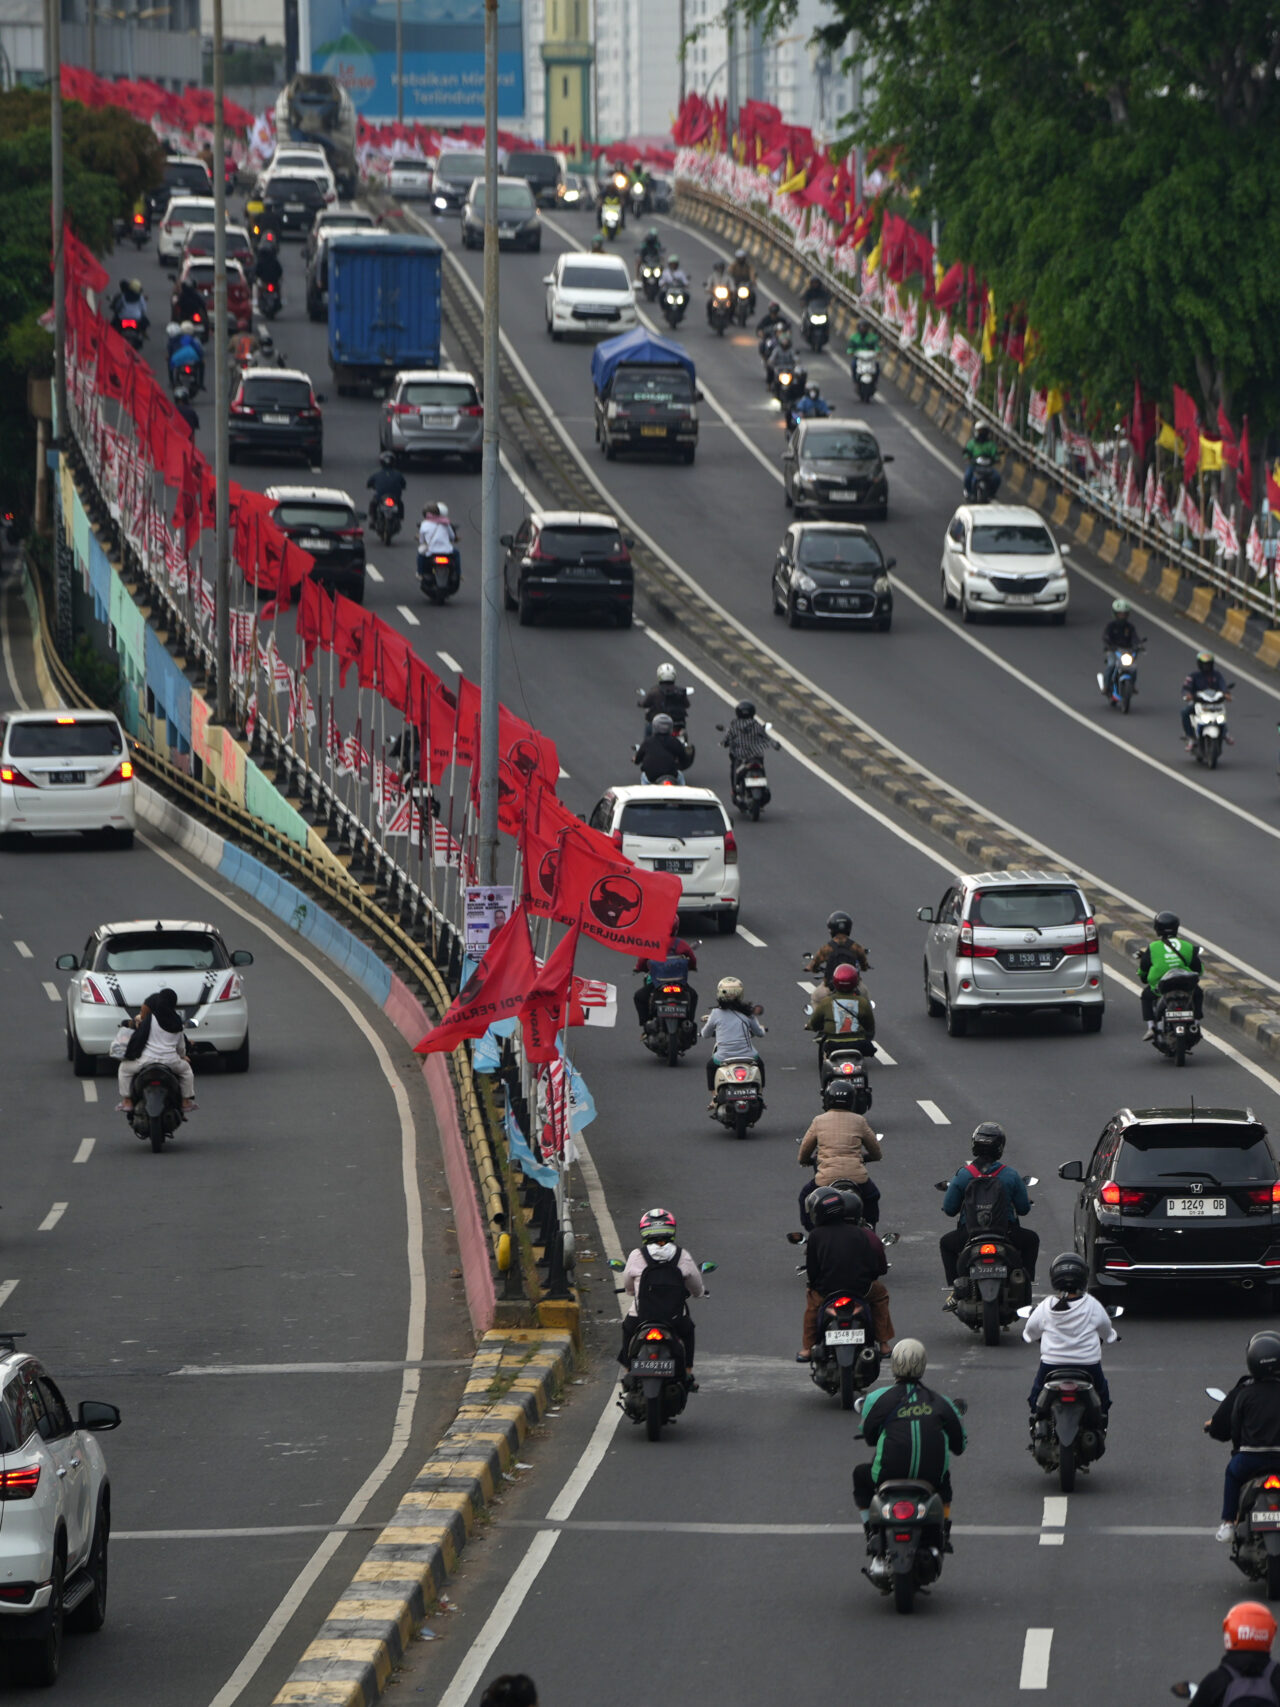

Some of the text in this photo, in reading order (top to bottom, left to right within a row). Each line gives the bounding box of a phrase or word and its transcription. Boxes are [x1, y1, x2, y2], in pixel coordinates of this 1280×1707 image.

[391, 72, 458, 86] Kebaikan
[582, 922, 661, 949] PERJUANGAN
[1169, 1200, 1175, 1210] D
[1181, 1200, 1204, 1210] 1249
[897, 1402, 933, 1418] Grab
